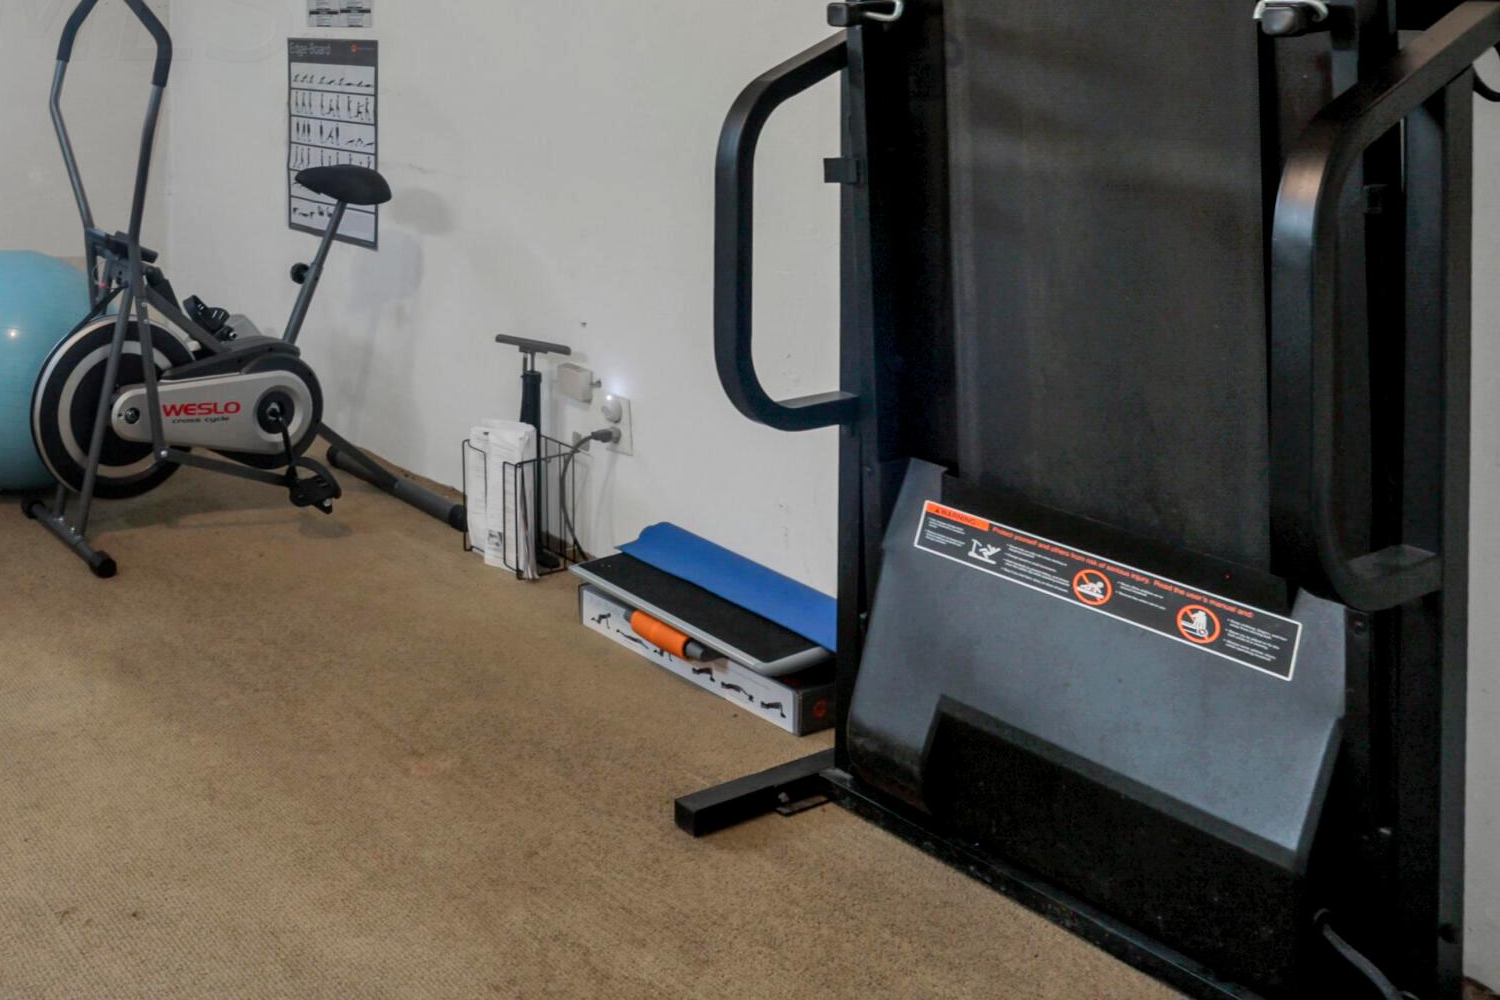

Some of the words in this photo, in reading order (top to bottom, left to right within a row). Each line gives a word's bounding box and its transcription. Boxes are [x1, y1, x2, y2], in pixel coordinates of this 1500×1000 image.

[162, 401, 241, 417] WESLO
[941, 508, 977, 525] WARNING
[1037, 541, 1050, 550] and
[1069, 551, 1085, 562] from
[1098, 561, 1106, 569] of
[1106, 563, 1130, 577] serious
[1153, 579, 1173, 591] Read
[1173, 586, 1185, 596] the
[1208, 598, 1236, 613] manual
